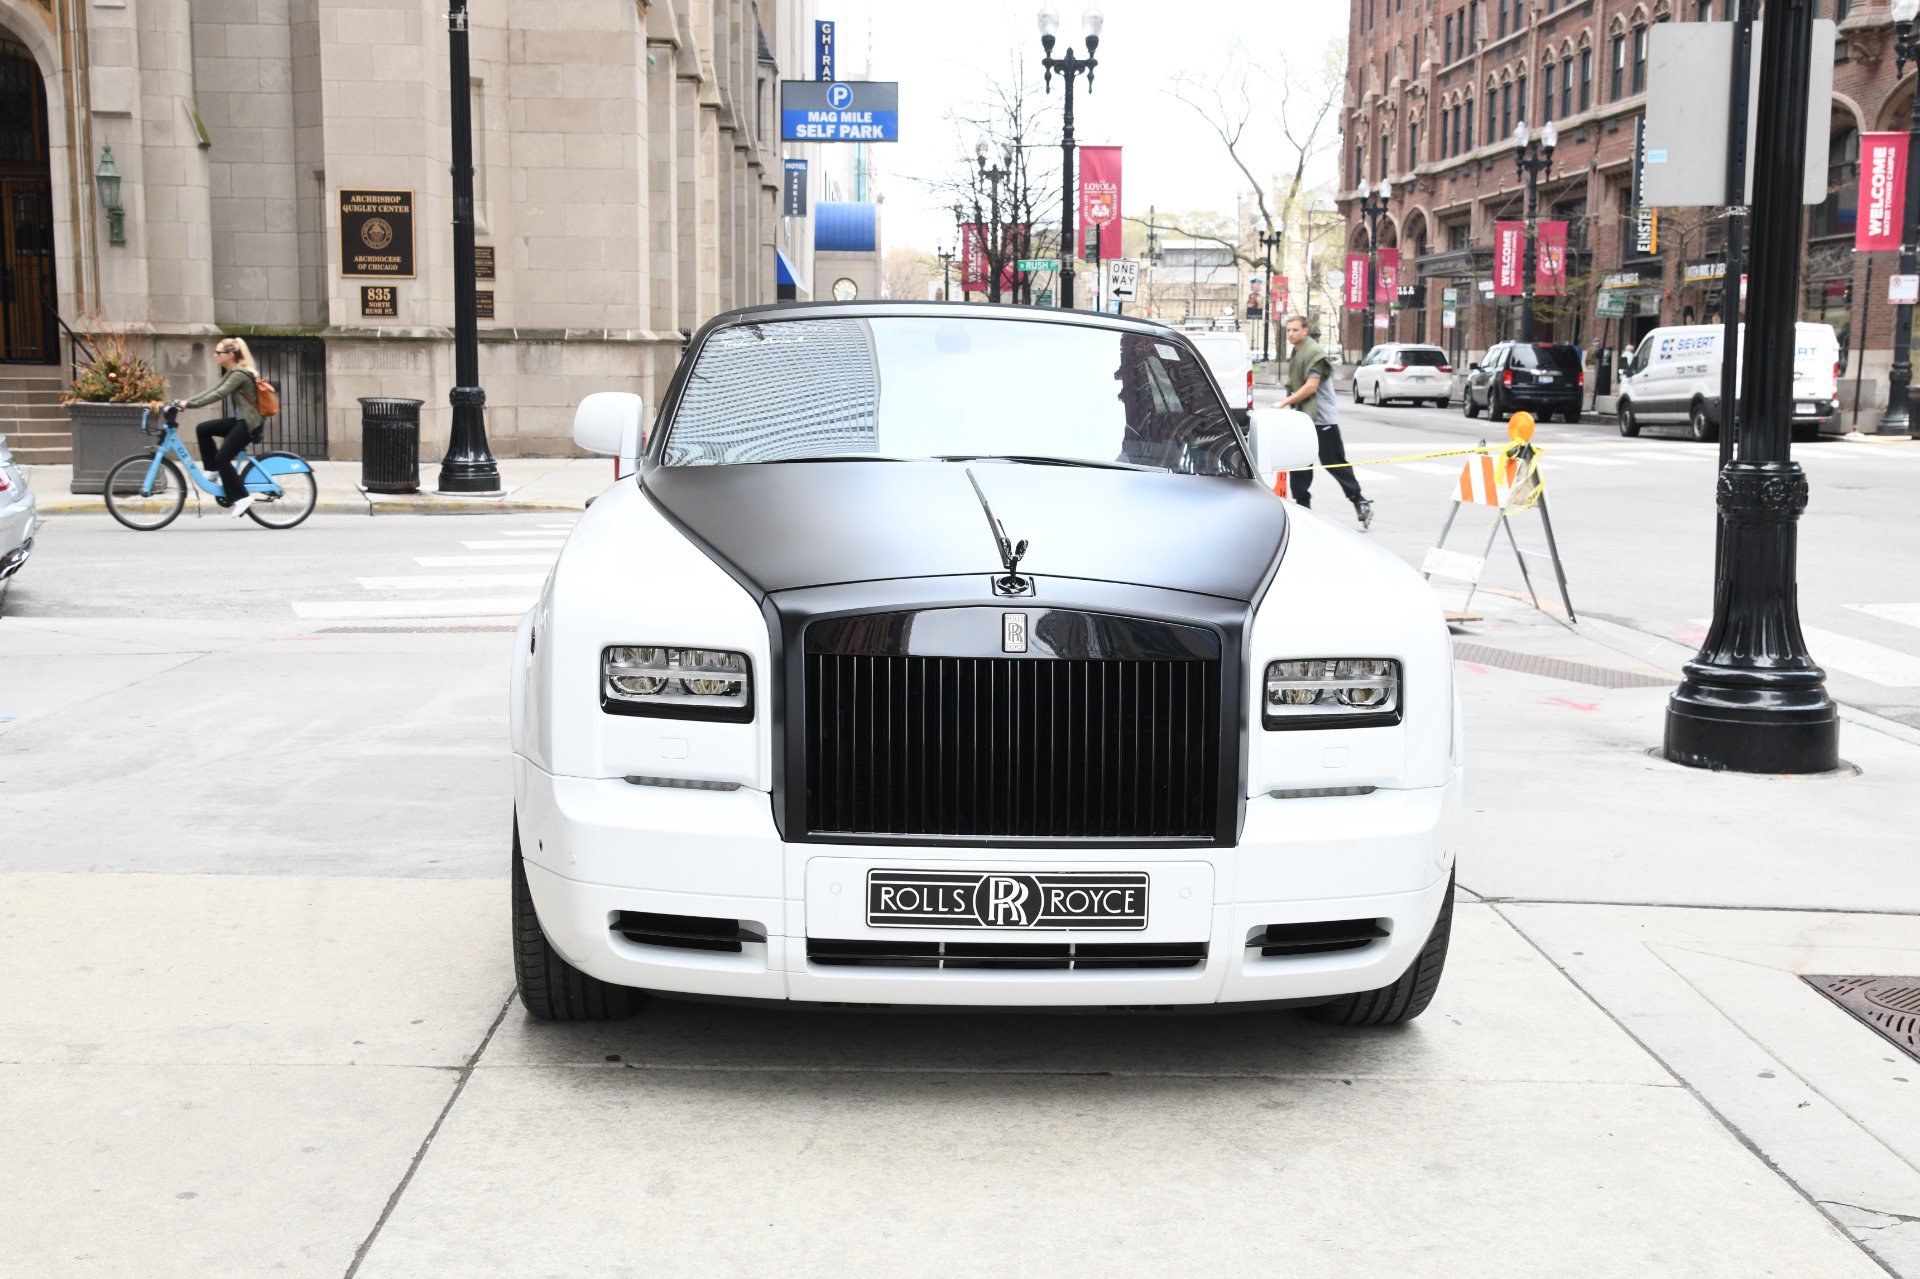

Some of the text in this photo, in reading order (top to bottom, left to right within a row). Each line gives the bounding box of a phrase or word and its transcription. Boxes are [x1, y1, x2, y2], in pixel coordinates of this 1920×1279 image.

[808, 111, 872, 123] MAG MILE
[796, 124, 884, 138] SELF PARK
[1084, 182, 1117, 191] LOYOLA
[1868, 147, 1888, 237] WELCOME
[1882, 147, 1896, 237] WATER TOWER CAMPUS
[350, 195, 402, 204] ARCHBISHOP
[342, 204, 410, 213] QUIGLEY CENTER
[1500, 230, 1513, 287] WELCOME
[1025, 260, 1049, 270] RUSH
[1113, 264, 1136, 274] ONE
[1112, 275, 1135, 286] WAY
[367, 288, 391, 301] 835
[1677, 336, 1716, 350] SIEVERT
[880, 887, 966, 912] ROLLS
[1050, 890, 1135, 914] ROYCE
